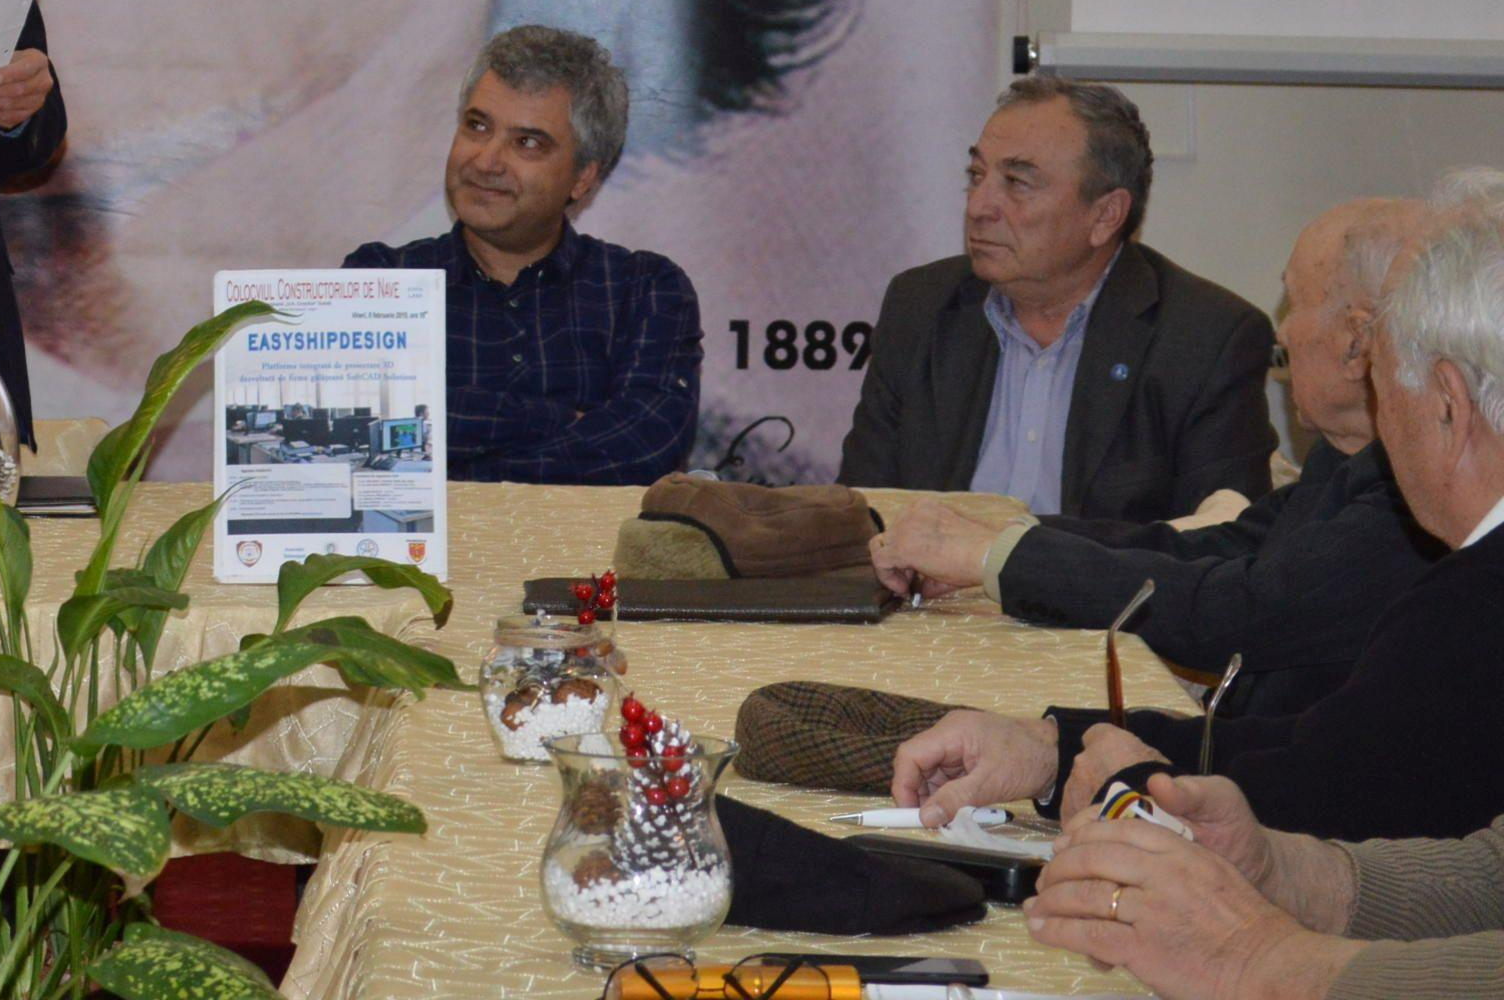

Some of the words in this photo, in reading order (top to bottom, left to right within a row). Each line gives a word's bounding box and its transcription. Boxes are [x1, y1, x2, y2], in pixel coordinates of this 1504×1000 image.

[226, 280, 275, 301] COLOCVIUL
[277, 278, 360, 300] CONSTRUCTORILOR
[362, 281, 374, 299] DE
[377, 277, 400, 299] NAVE
[248, 331, 407, 351] EASYSHIPDESIGN
[729, 319, 875, 370] 1889
